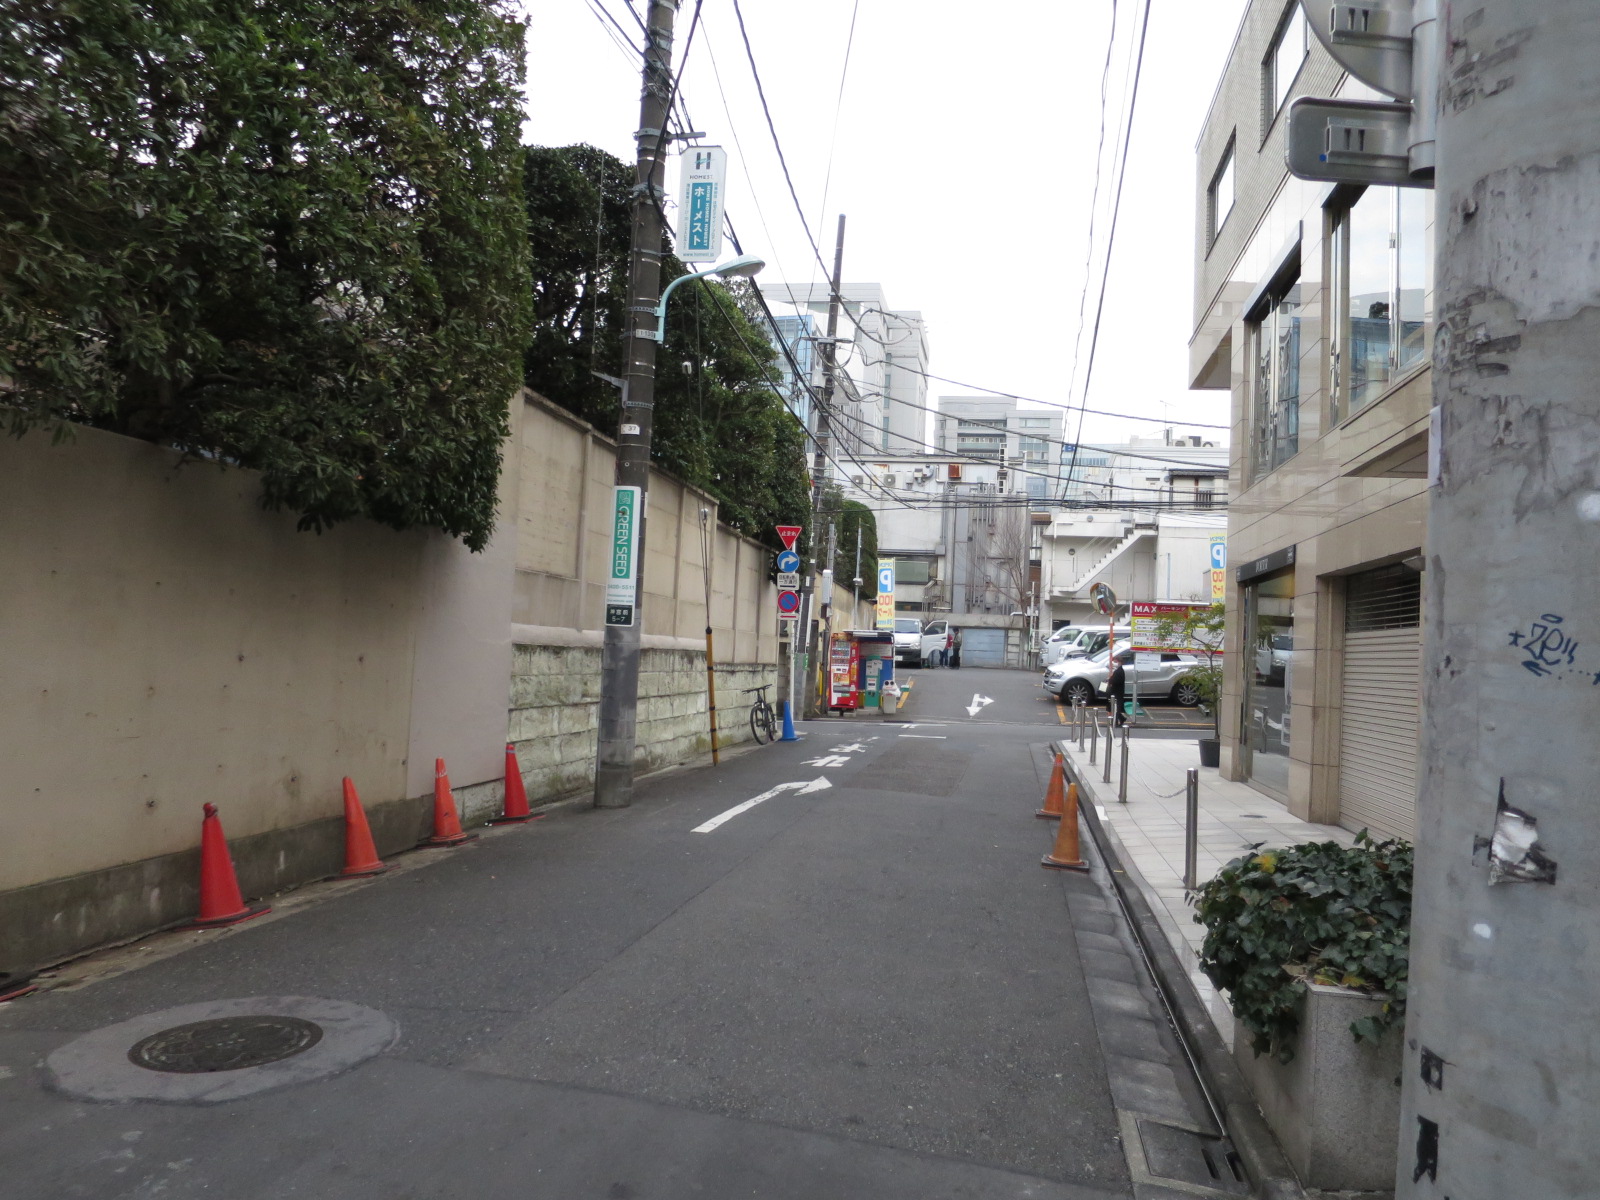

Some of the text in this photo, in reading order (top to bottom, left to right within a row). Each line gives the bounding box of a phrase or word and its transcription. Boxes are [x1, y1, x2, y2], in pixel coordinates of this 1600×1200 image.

[692, 186, 705, 246] ホーメスト
[616, 505, 630, 544] GREEN
[615, 546, 628, 577] SEED
[1134, 605, 1157, 613] MAX
